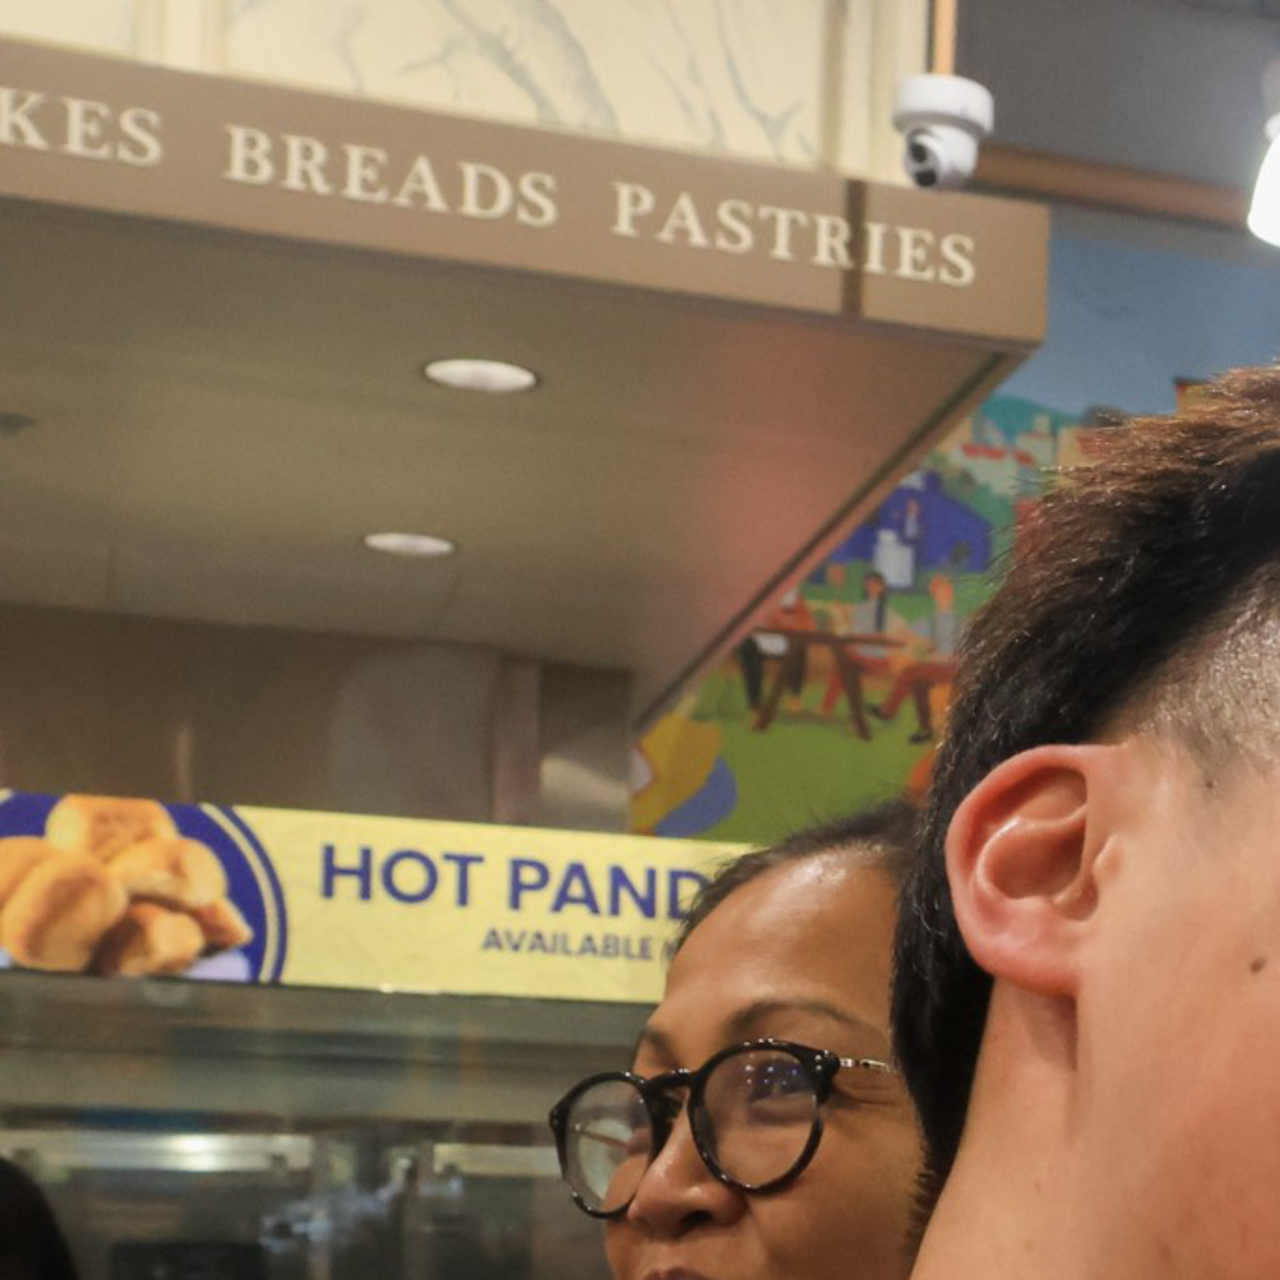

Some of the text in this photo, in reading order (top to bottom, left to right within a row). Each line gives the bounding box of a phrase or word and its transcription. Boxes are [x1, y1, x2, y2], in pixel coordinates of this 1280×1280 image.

[224, 124, 559, 229] BREADS
[611, 180, 977, 287] PASTRIES
[319, 843, 486, 908] HOT
[482, 927, 655, 961] AVAILABLE
